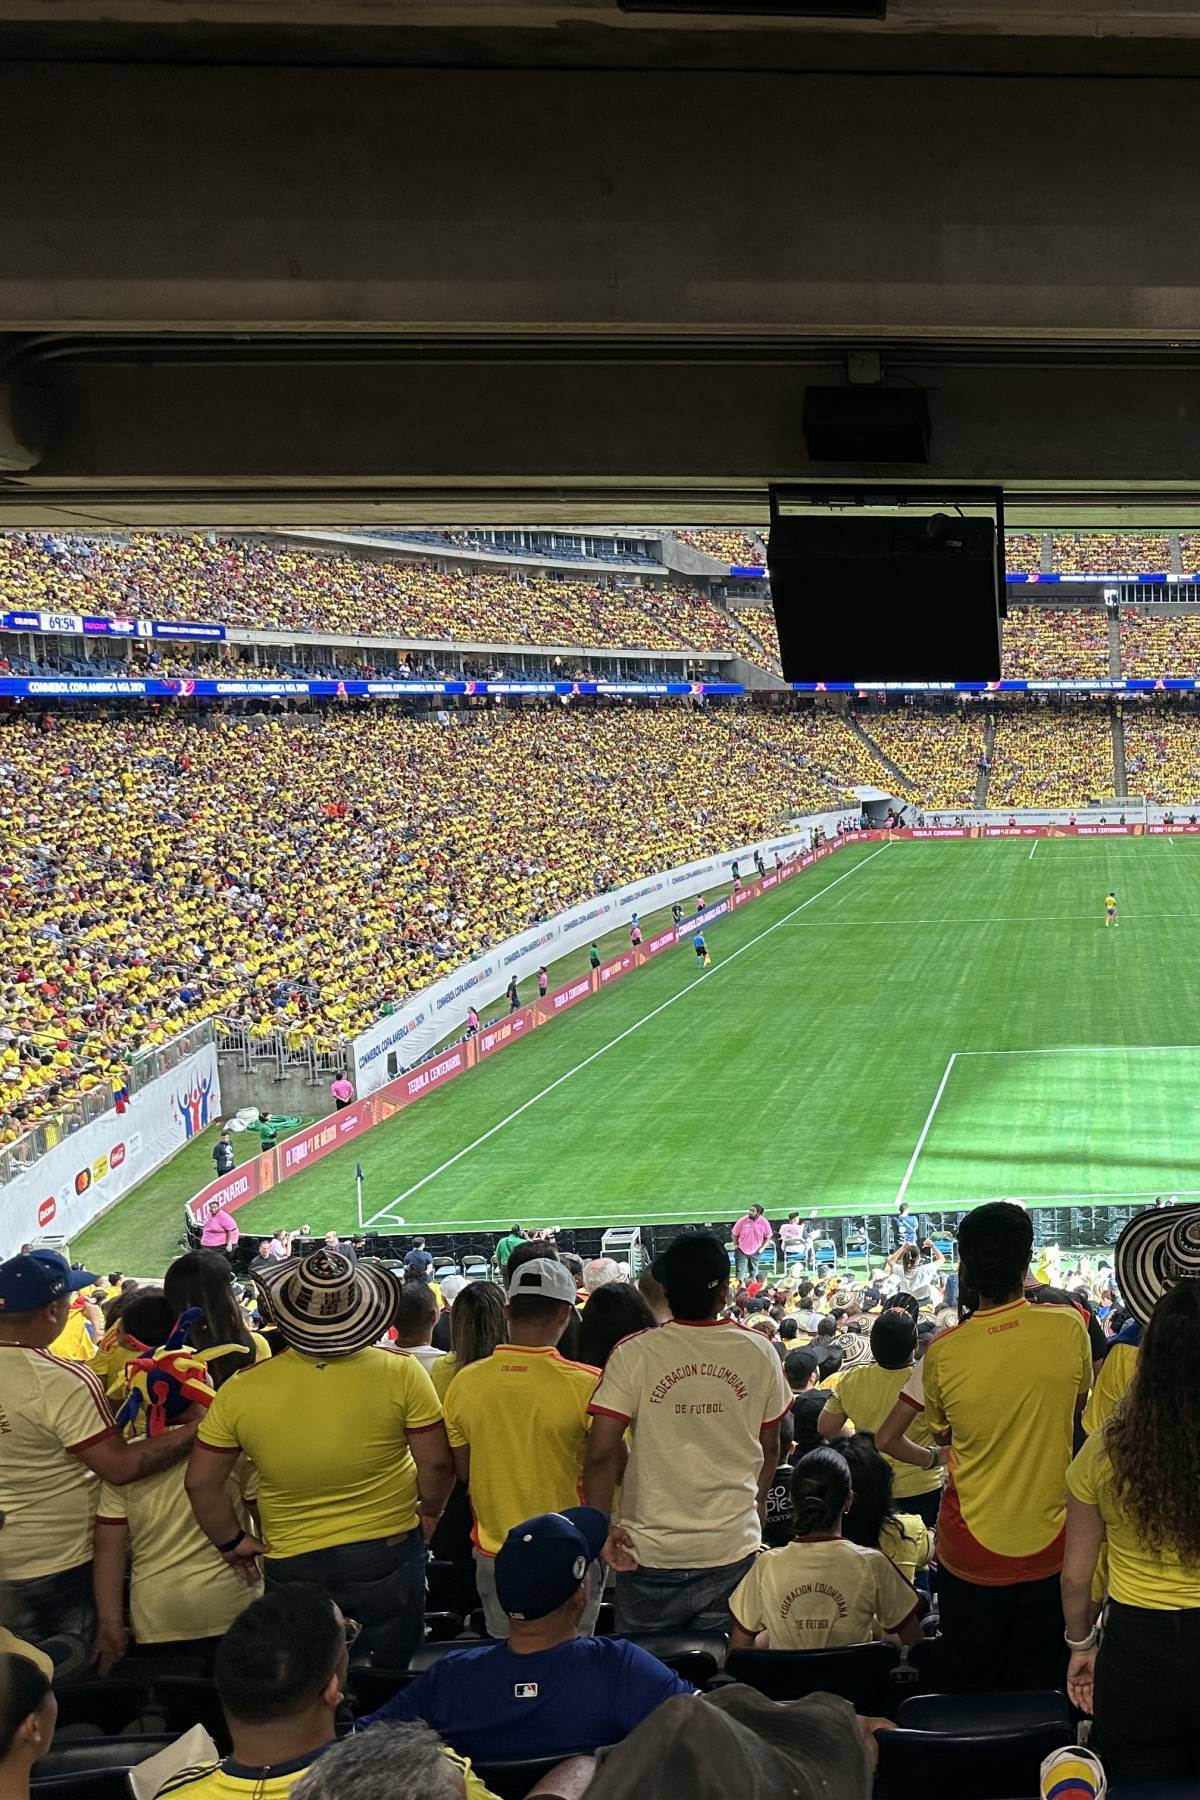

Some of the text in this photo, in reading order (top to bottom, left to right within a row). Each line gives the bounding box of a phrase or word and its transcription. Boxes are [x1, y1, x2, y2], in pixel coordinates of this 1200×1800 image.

[49, 613, 75, 631] 69:54
[359, 1013, 424, 1069] CONMEBOL COPA AMERICA USA 2024
[408, 1054, 461, 1095] TEQUILA CENTENARIO
[988, 1320, 1019, 1334] COLOMBIA
[650, 1364, 748, 1404] FEDERACION COLOMBIANA
[675, 1402, 723, 1414] DE FUTBOL
